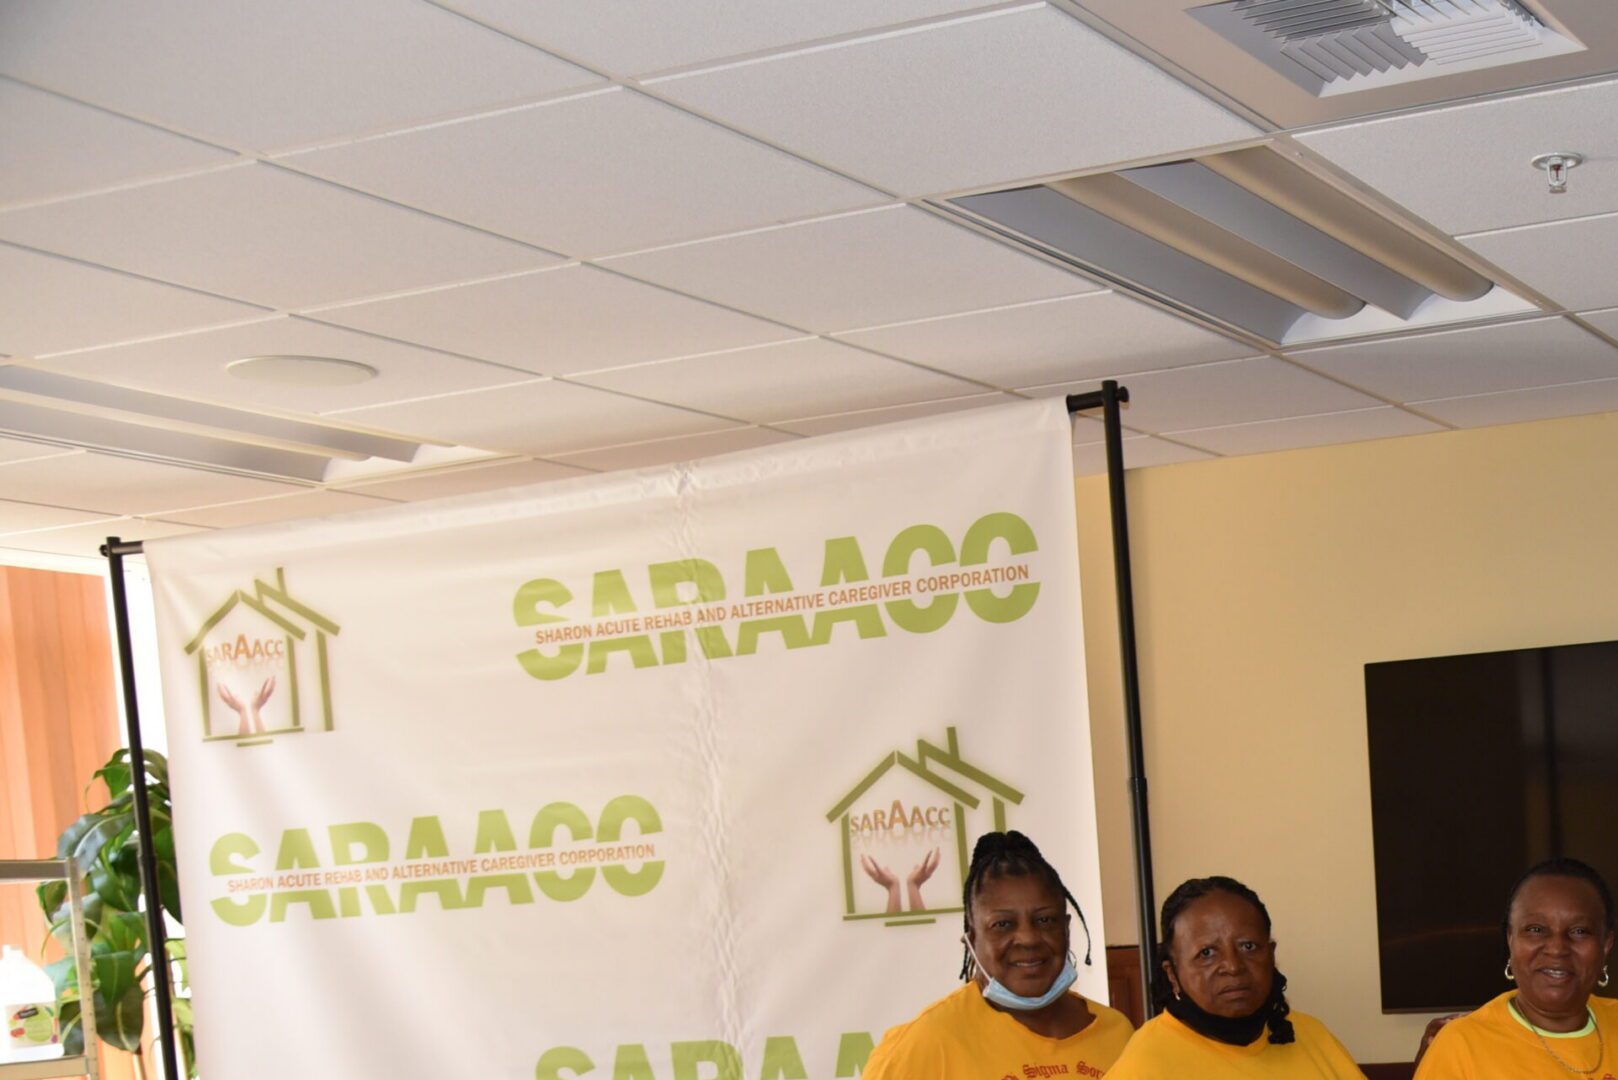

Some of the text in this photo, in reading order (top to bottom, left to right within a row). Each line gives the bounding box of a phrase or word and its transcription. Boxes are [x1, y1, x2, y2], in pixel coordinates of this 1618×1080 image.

[512, 511, 1041, 682] SARAACC
[535, 563, 1030, 646] SHARON ACUTE REHAB AND ALTERNATIVE CAREGIVER CORPORATION
[850, 799, 951, 834] SARAACC
[208, 794, 667, 929] SARAACC
[227, 843, 656, 893] SHARON ACUTE REHAB AND ALTERNATIVE CAREGIVER CORPORATION
[1022, 1063, 1069, 1080] Sigma
